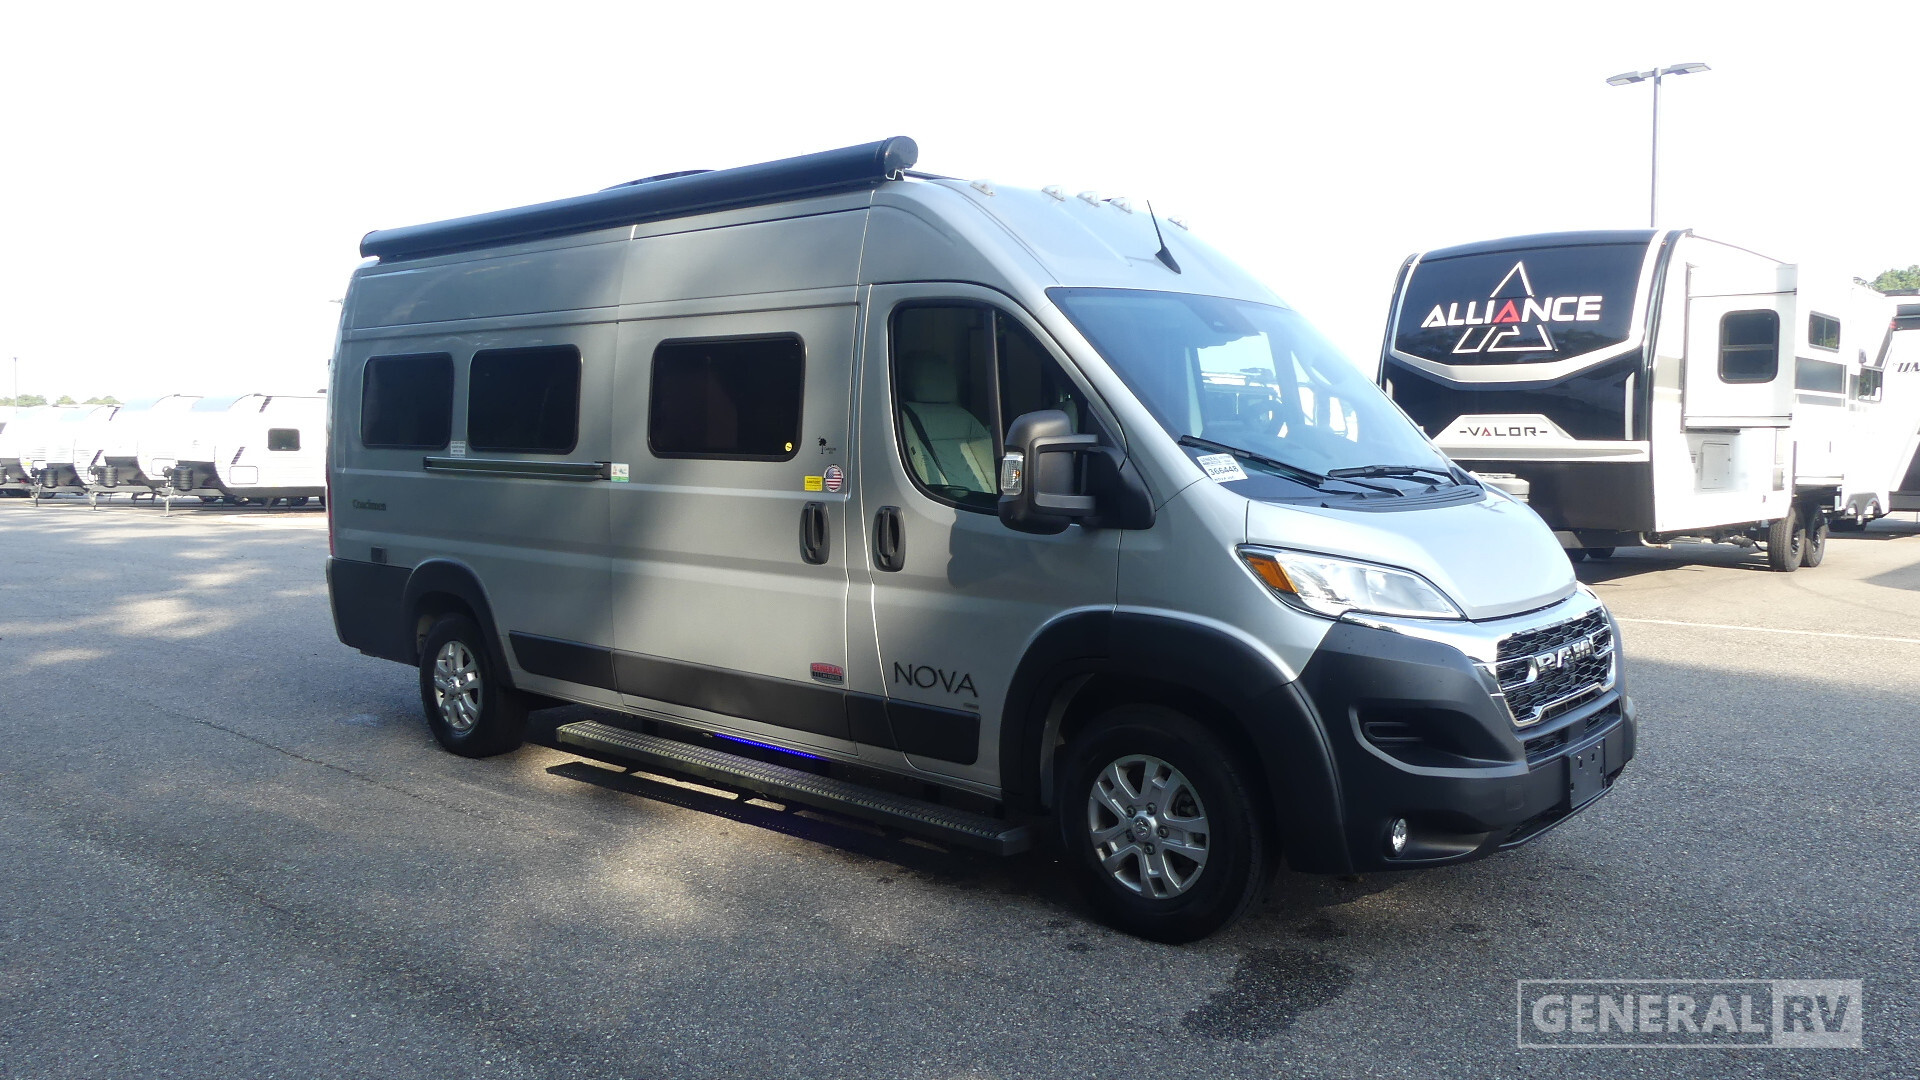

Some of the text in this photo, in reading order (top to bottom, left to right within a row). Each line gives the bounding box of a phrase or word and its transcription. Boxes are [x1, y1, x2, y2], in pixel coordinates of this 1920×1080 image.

[1421, 296, 1603, 328] ALLIANCE
[1208, 465, 1239, 475] 366448
[1535, 639, 1591, 671] RAM
[894, 662, 979, 698] NOVA
